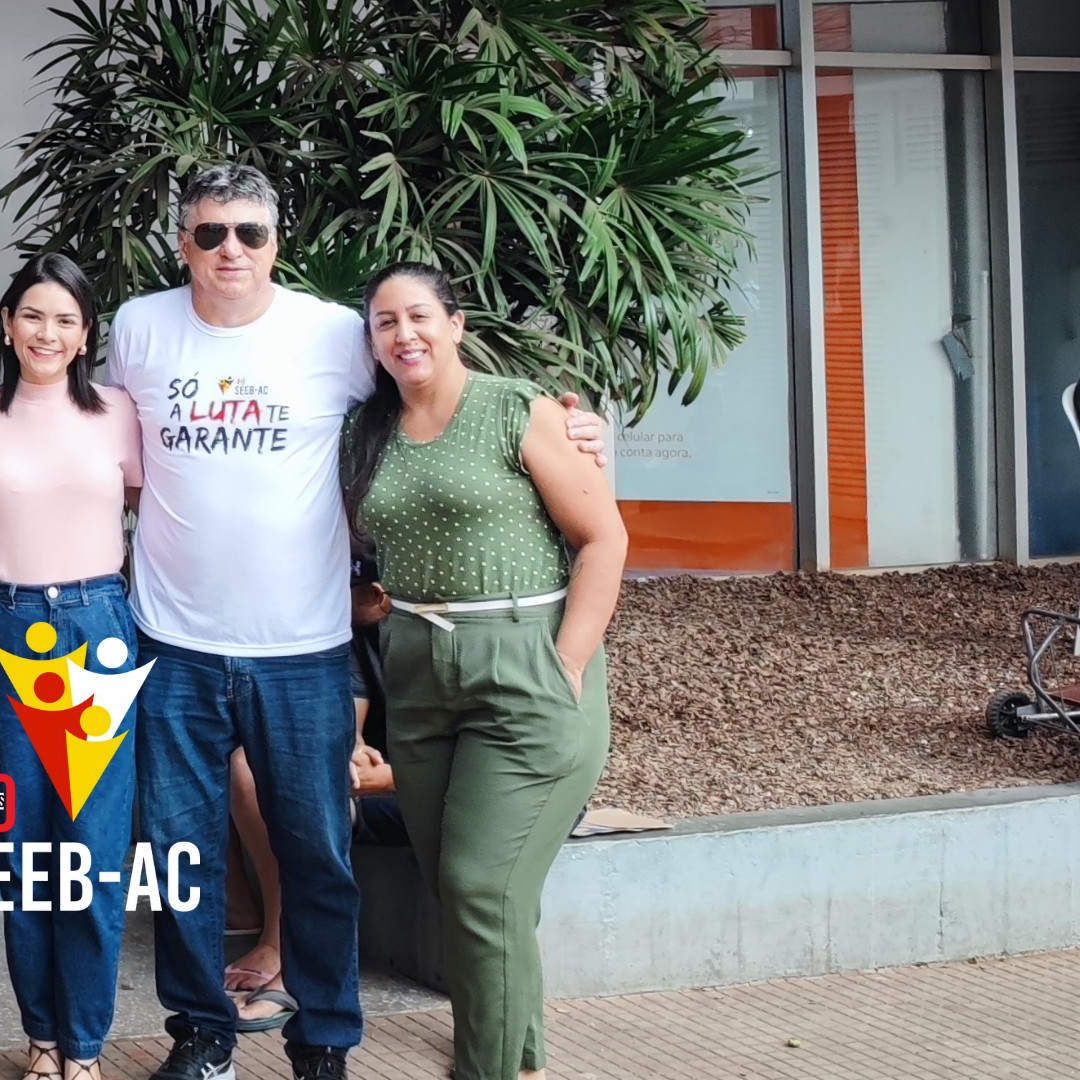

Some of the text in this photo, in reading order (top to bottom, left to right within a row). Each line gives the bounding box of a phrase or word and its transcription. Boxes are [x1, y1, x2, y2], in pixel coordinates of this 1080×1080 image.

[167, 371, 199, 400] SÓ
[235, 386, 269, 395] SEEB-AC
[169, 399, 290, 425] A LUTA TE
[160, 425, 288, 455] GARANTE
[617, 431, 684, 444] celular para
[620, 448, 653, 458] conta
[655, 449, 692, 460] agora.
